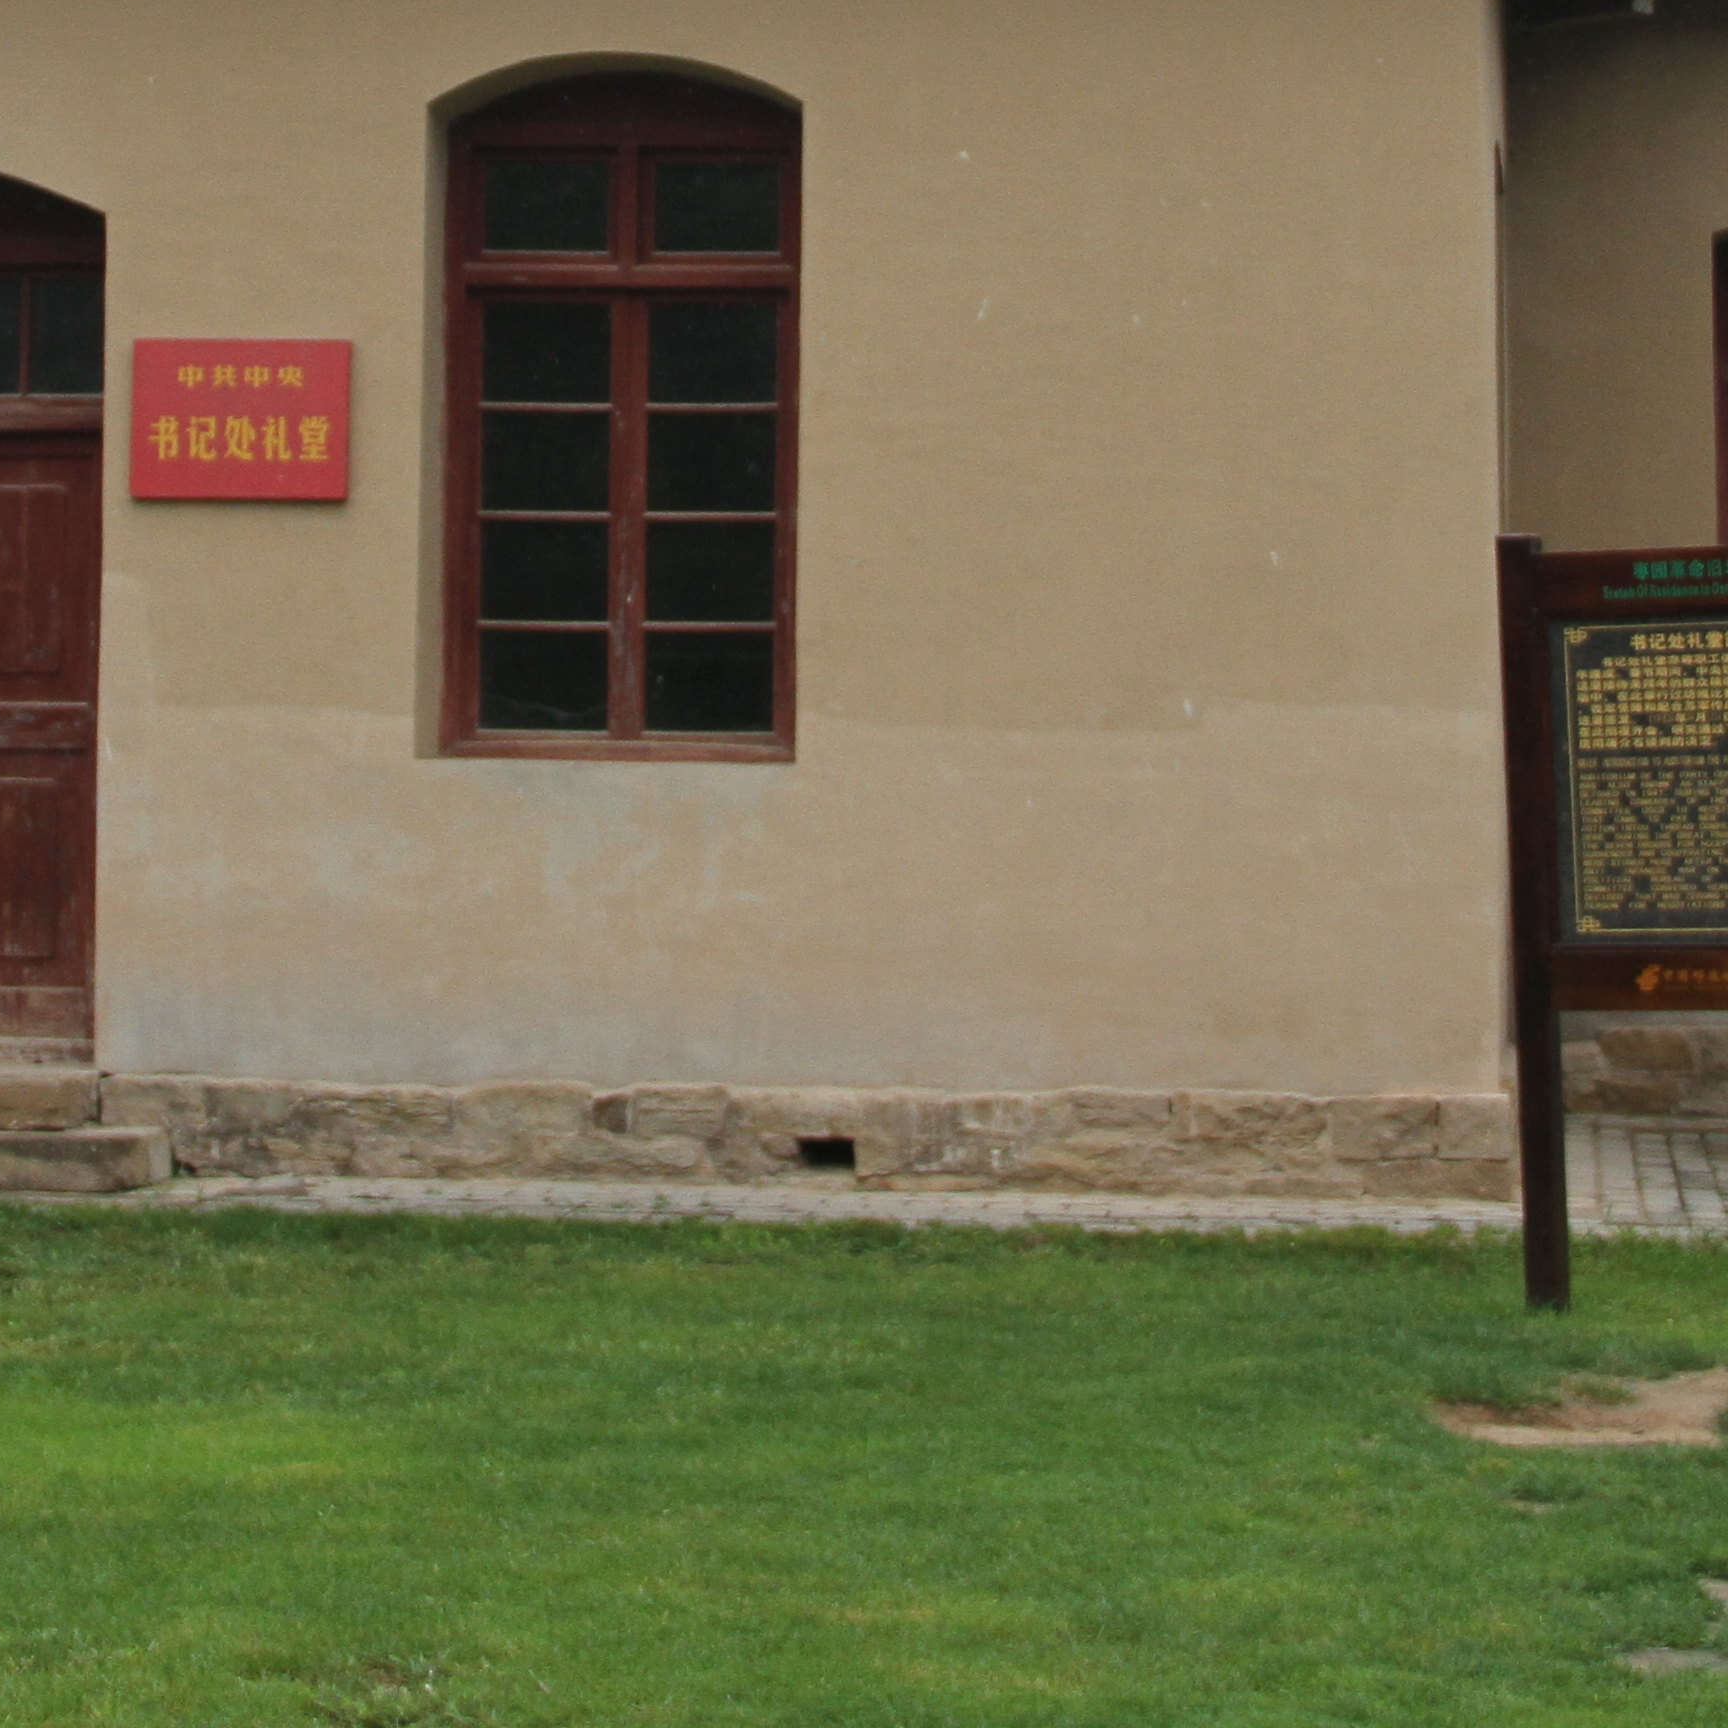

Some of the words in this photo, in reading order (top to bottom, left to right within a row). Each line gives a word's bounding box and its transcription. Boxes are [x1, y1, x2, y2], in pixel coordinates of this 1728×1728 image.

[177, 364, 305, 388] 中共中央
[148, 415, 332, 461] 书记处礼堂
